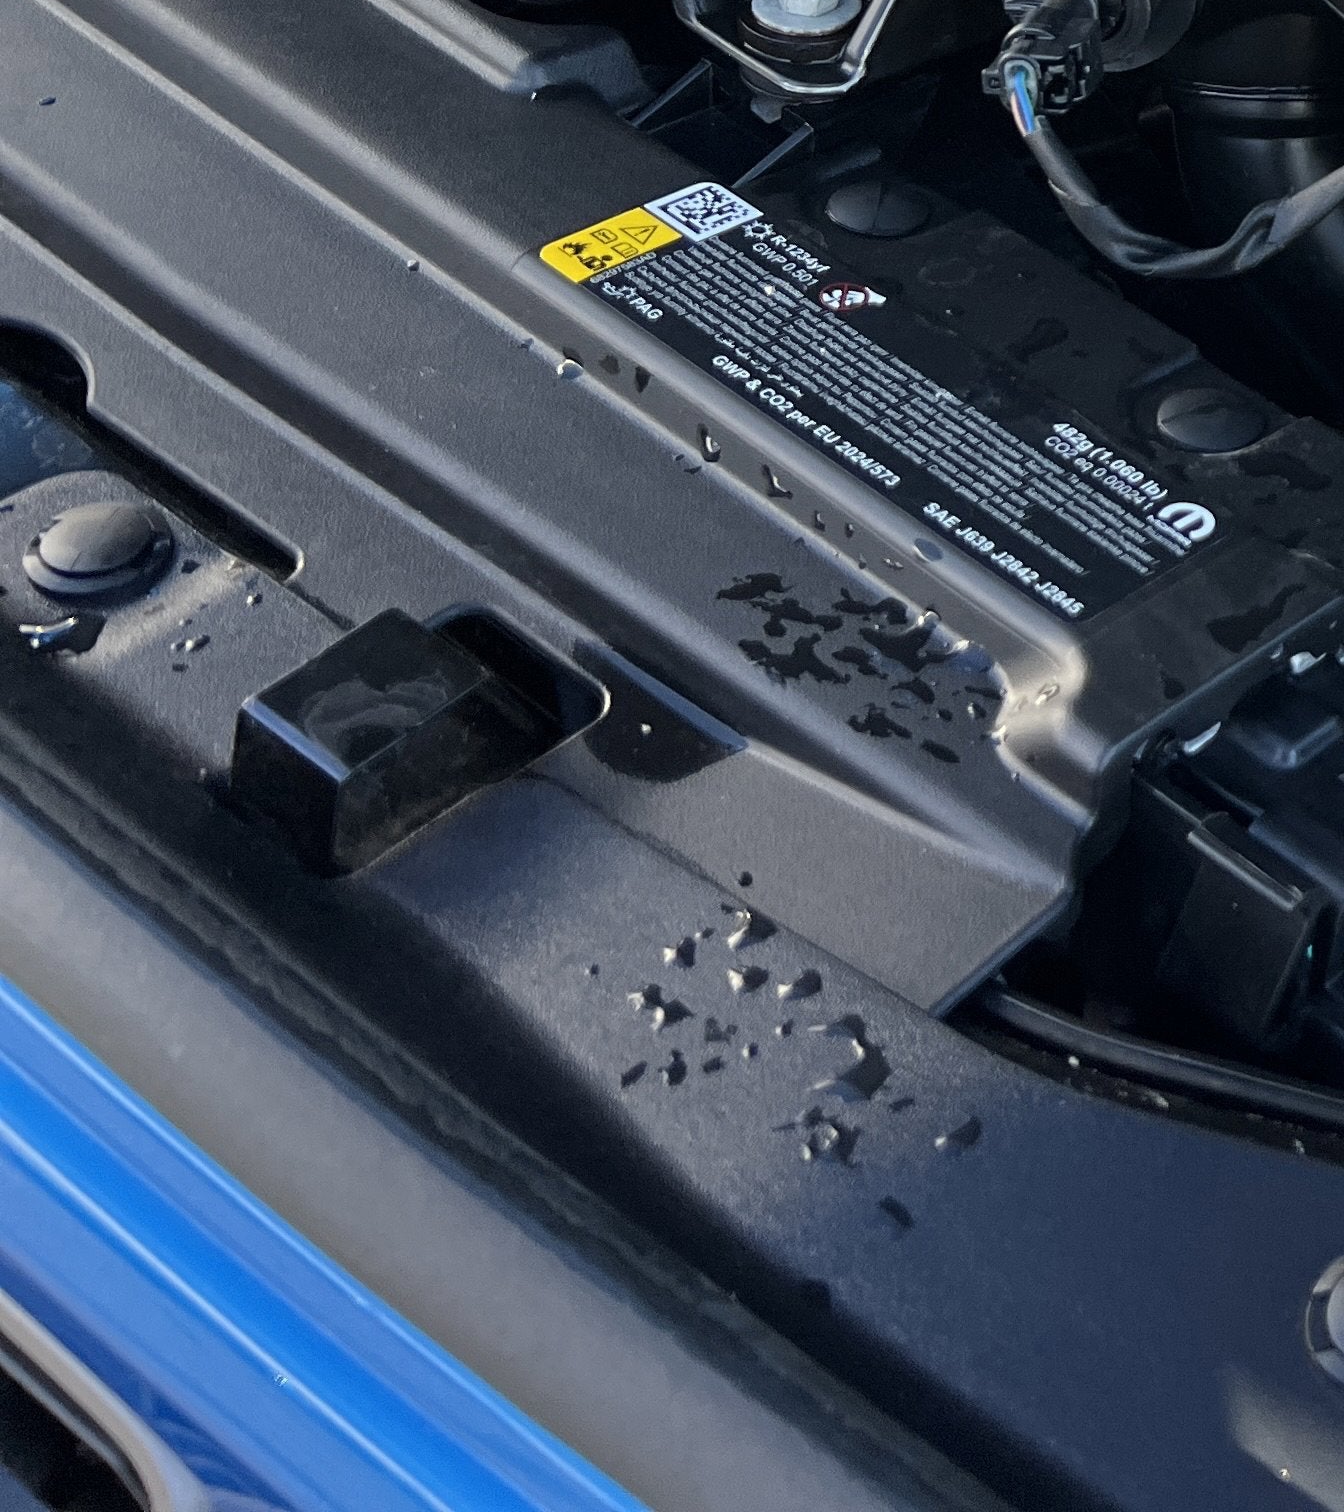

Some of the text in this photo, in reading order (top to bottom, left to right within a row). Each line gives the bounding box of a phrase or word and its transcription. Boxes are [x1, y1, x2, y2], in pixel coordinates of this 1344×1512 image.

[752, 238, 819, 289] GWP 0.501
[770, 234, 831, 273] R-1234yf
[628, 296, 664, 320] PAG
[712, 355, 901, 486] GWP & CO2 per EU 2024/573
[1044, 436, 1084, 460] CO2
[1073, 457, 1094, 473] eq
[1052, 423, 1169, 501] 482g (1.060 lb)
[922, 502, 1085, 614] SAE J639 J2842 J2845
